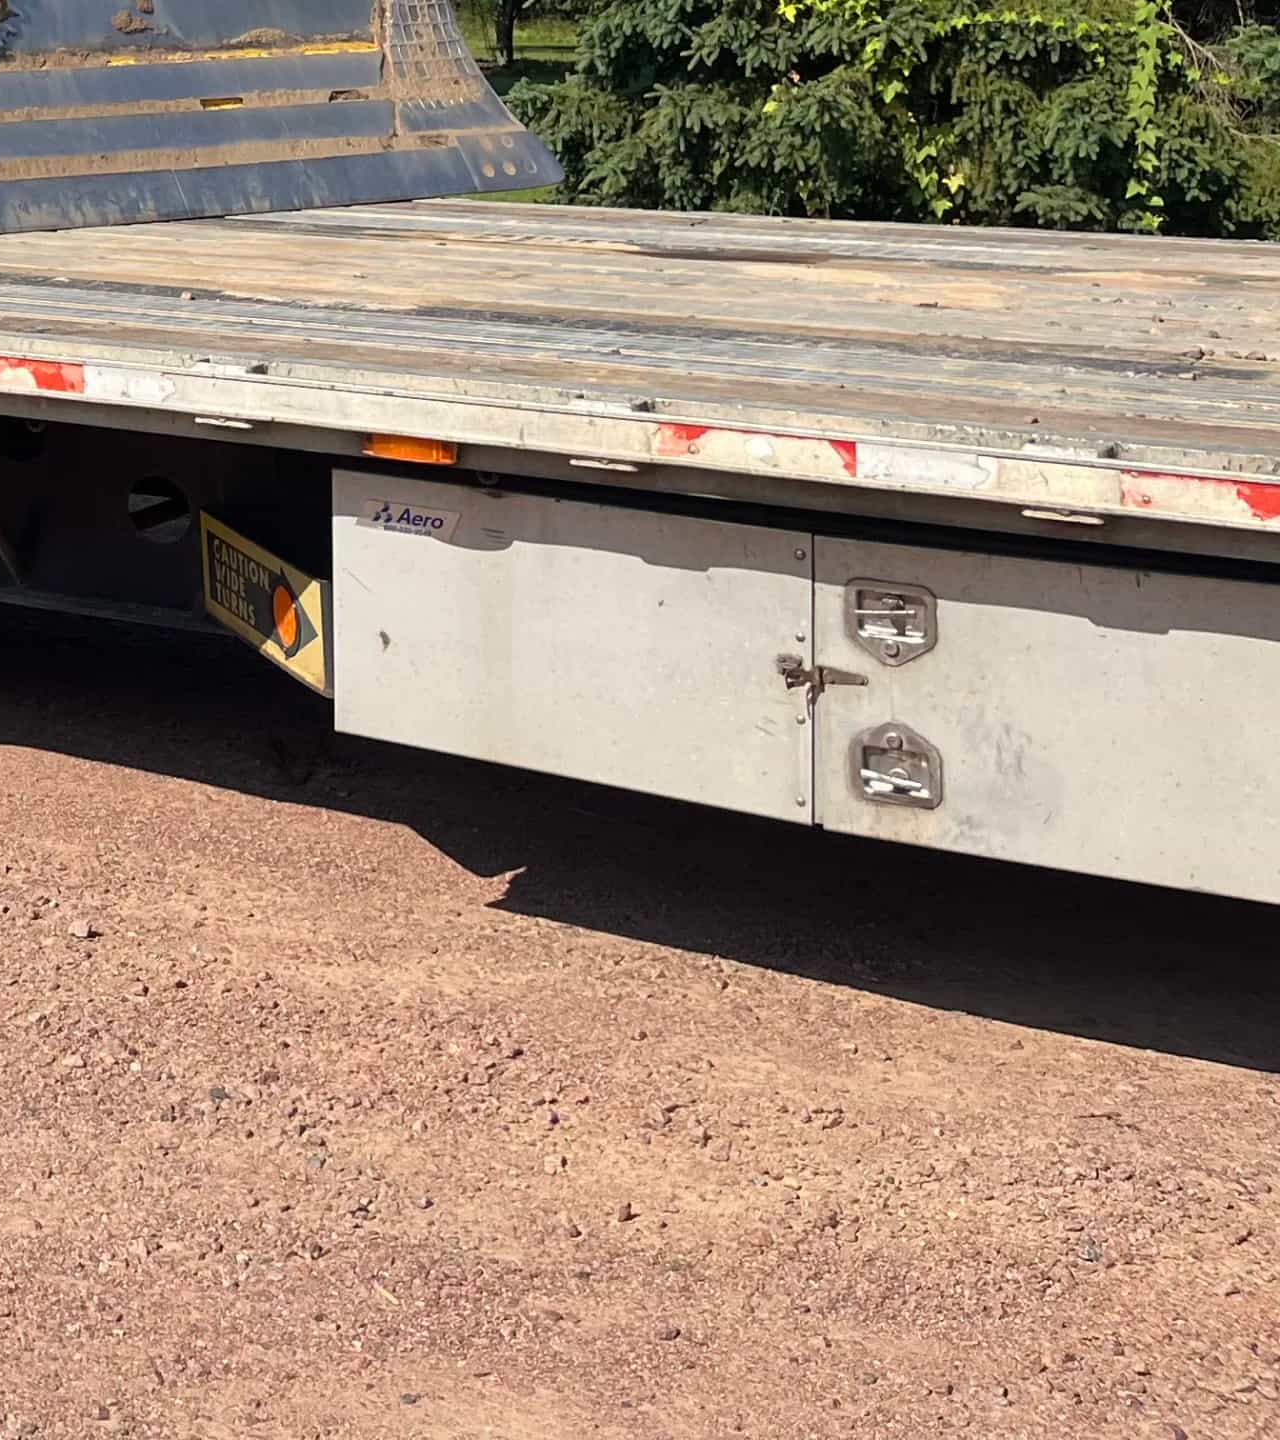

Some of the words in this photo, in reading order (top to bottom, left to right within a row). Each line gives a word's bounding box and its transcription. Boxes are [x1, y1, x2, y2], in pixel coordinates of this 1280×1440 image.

[396, 507, 444, 529] Aero
[214, 539, 272, 594] CAUTION
[214, 559, 246, 598] WIDE
[215, 581, 256, 626] TURNS
